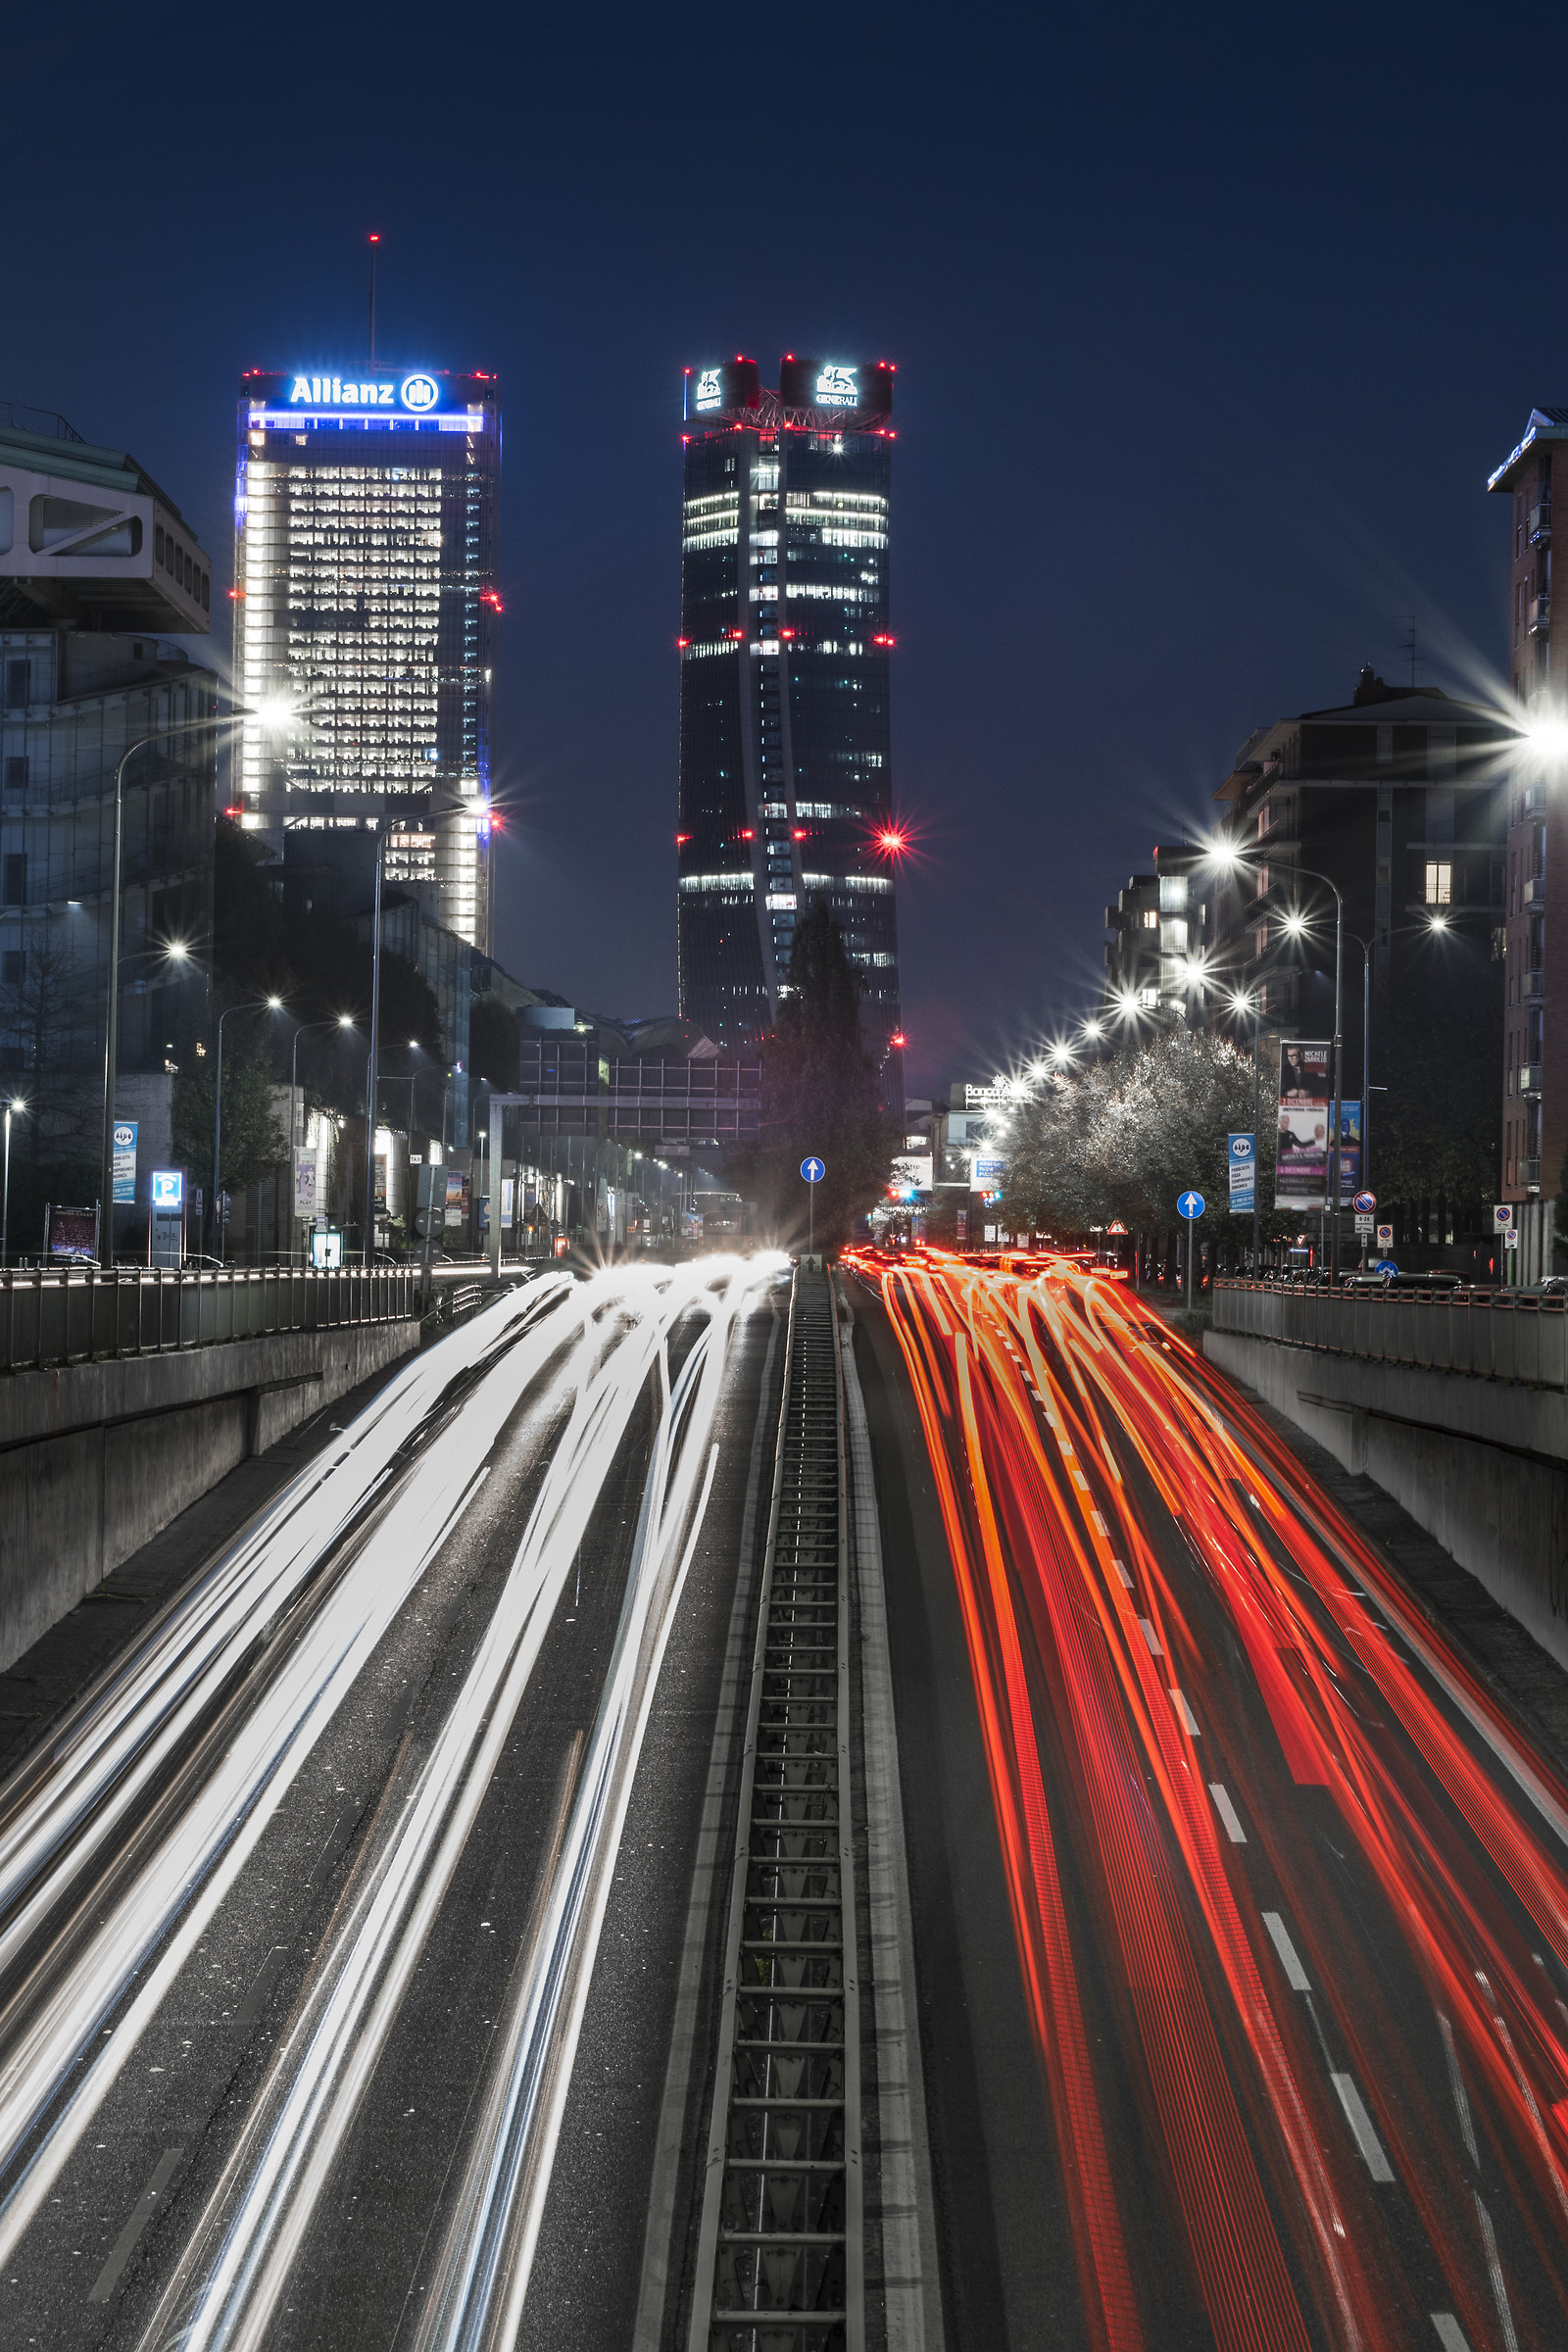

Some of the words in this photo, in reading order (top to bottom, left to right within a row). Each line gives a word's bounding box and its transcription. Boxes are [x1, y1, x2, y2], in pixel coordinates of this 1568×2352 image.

[290, 377, 394, 404] Allianz
[815, 394, 858, 407] GENERALI
[161, 1180, 174, 1196] P
